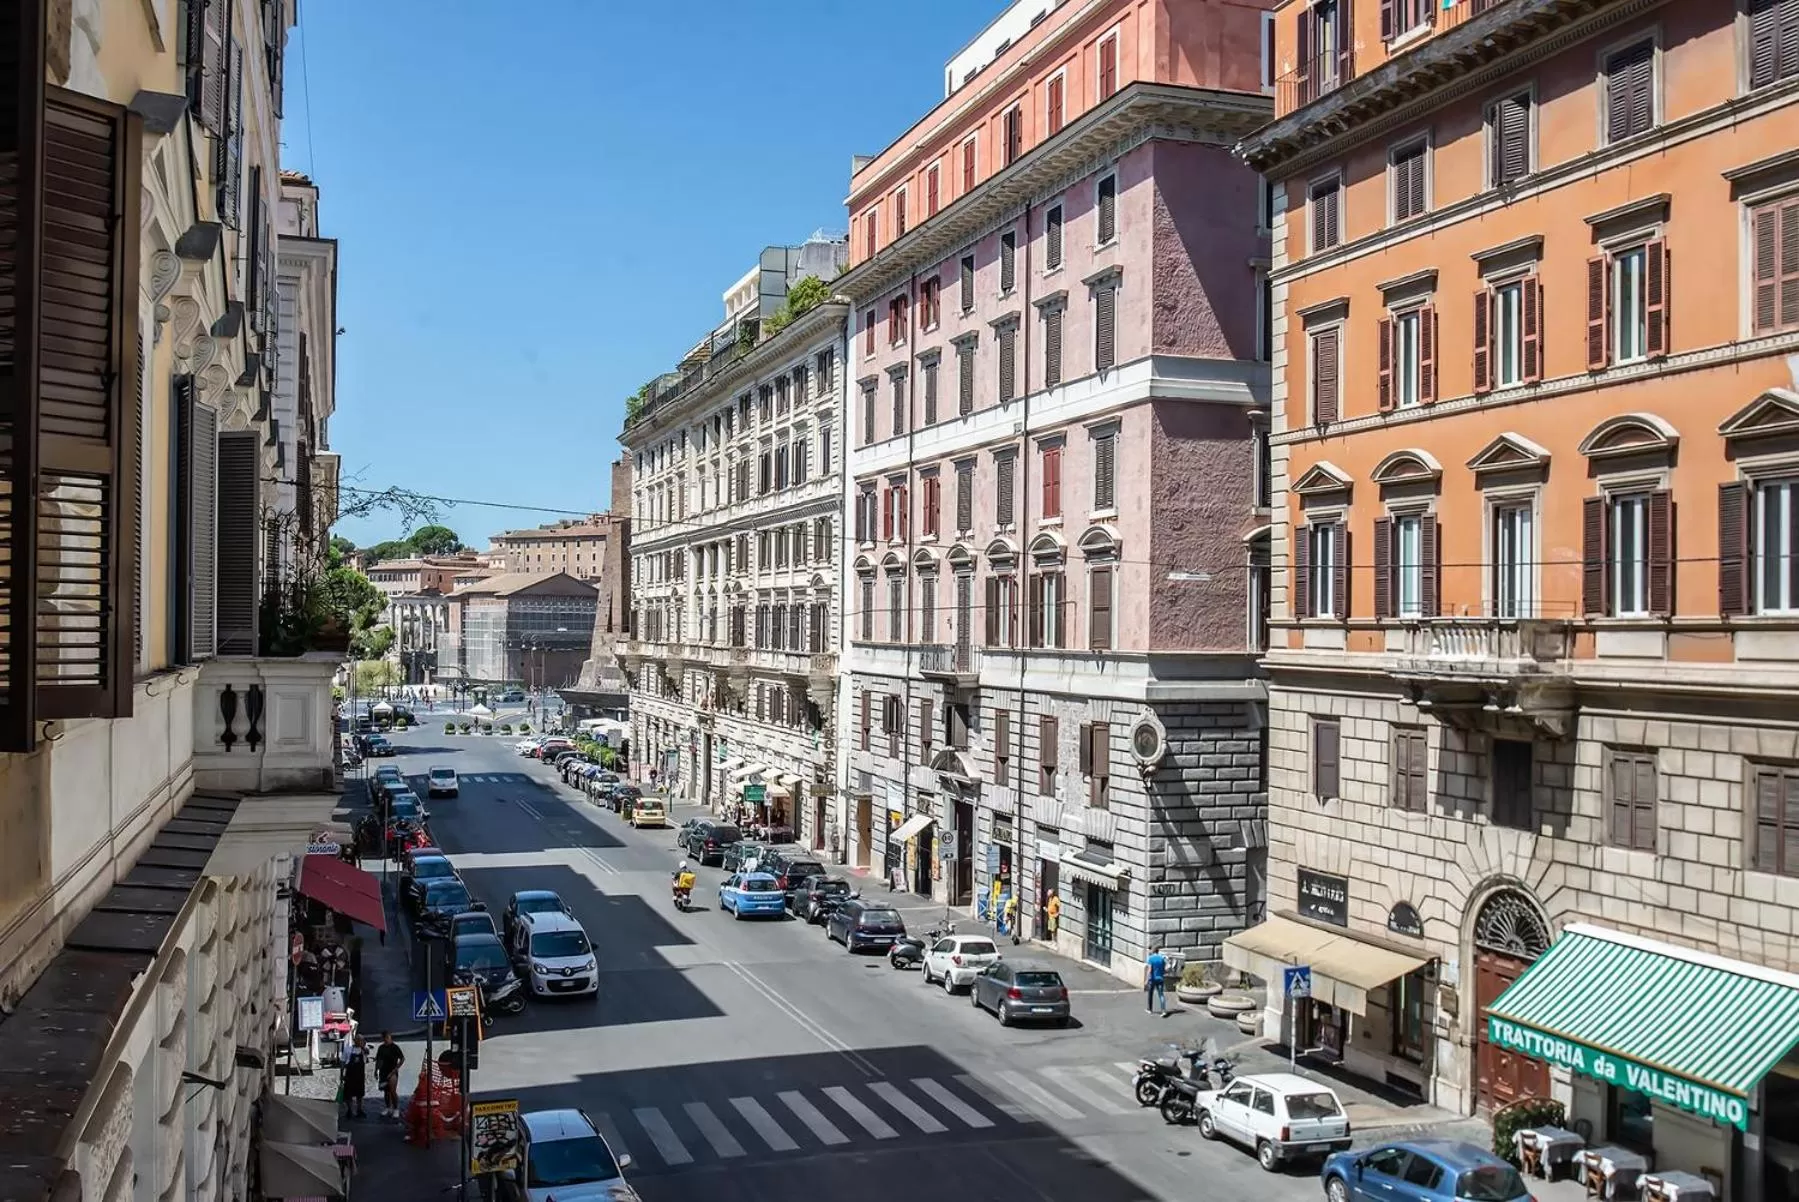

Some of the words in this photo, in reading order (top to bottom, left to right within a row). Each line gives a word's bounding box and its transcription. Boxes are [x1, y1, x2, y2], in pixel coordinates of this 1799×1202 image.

[1492, 1019, 1585, 1068] TRATTORIA
[1594, 1055, 1616, 1079] da
[1625, 1064, 1744, 1123] VALENTINO
